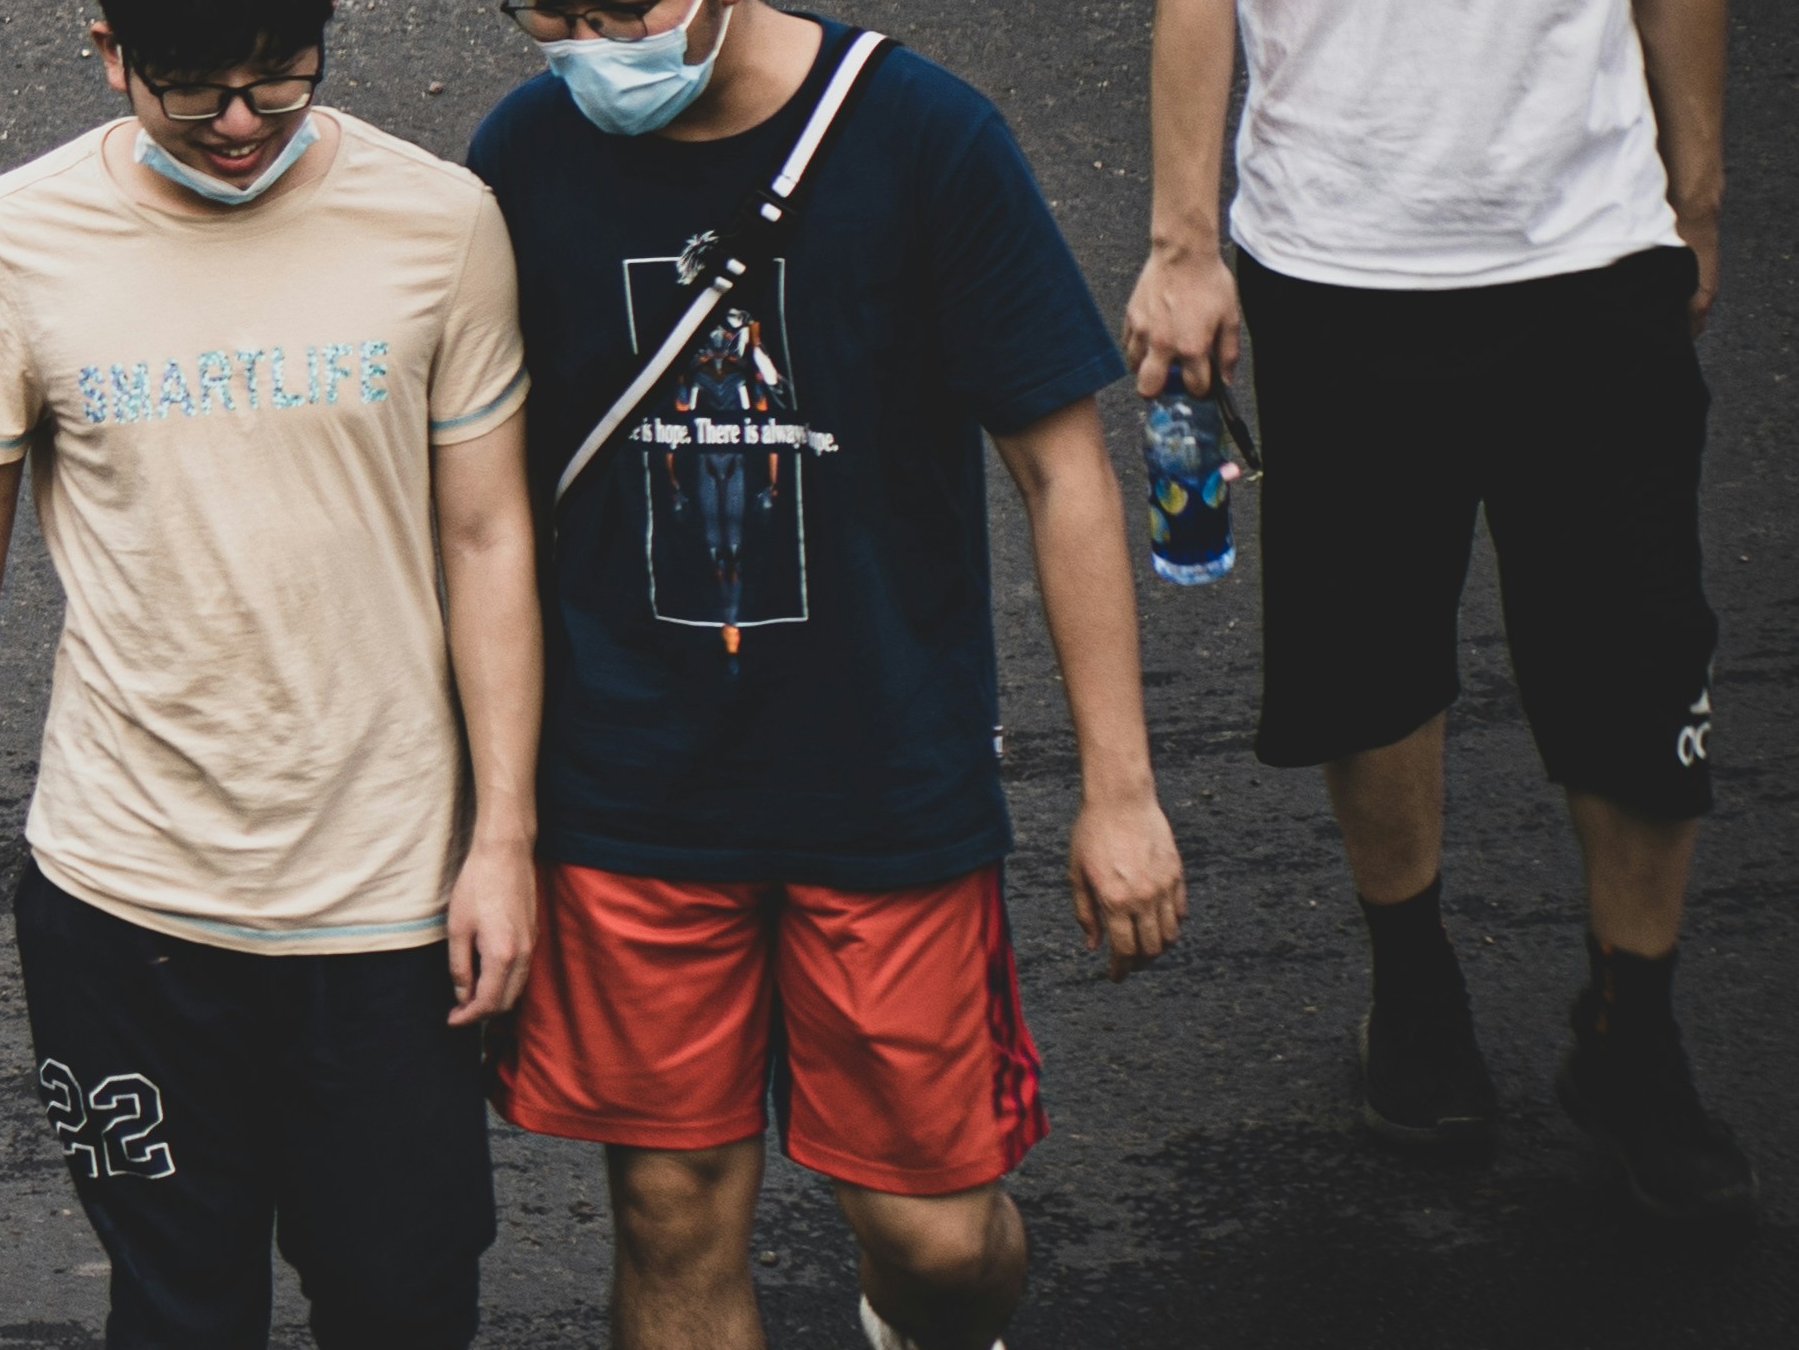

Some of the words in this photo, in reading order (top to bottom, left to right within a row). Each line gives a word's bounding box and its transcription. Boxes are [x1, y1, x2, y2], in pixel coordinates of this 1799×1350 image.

[78, 340, 389, 425] SMARTLIFE
[654, 417, 692, 450] hope.
[694, 417, 741, 445] There
[744, 417, 759, 444] is
[39, 1057, 176, 1180] 22
